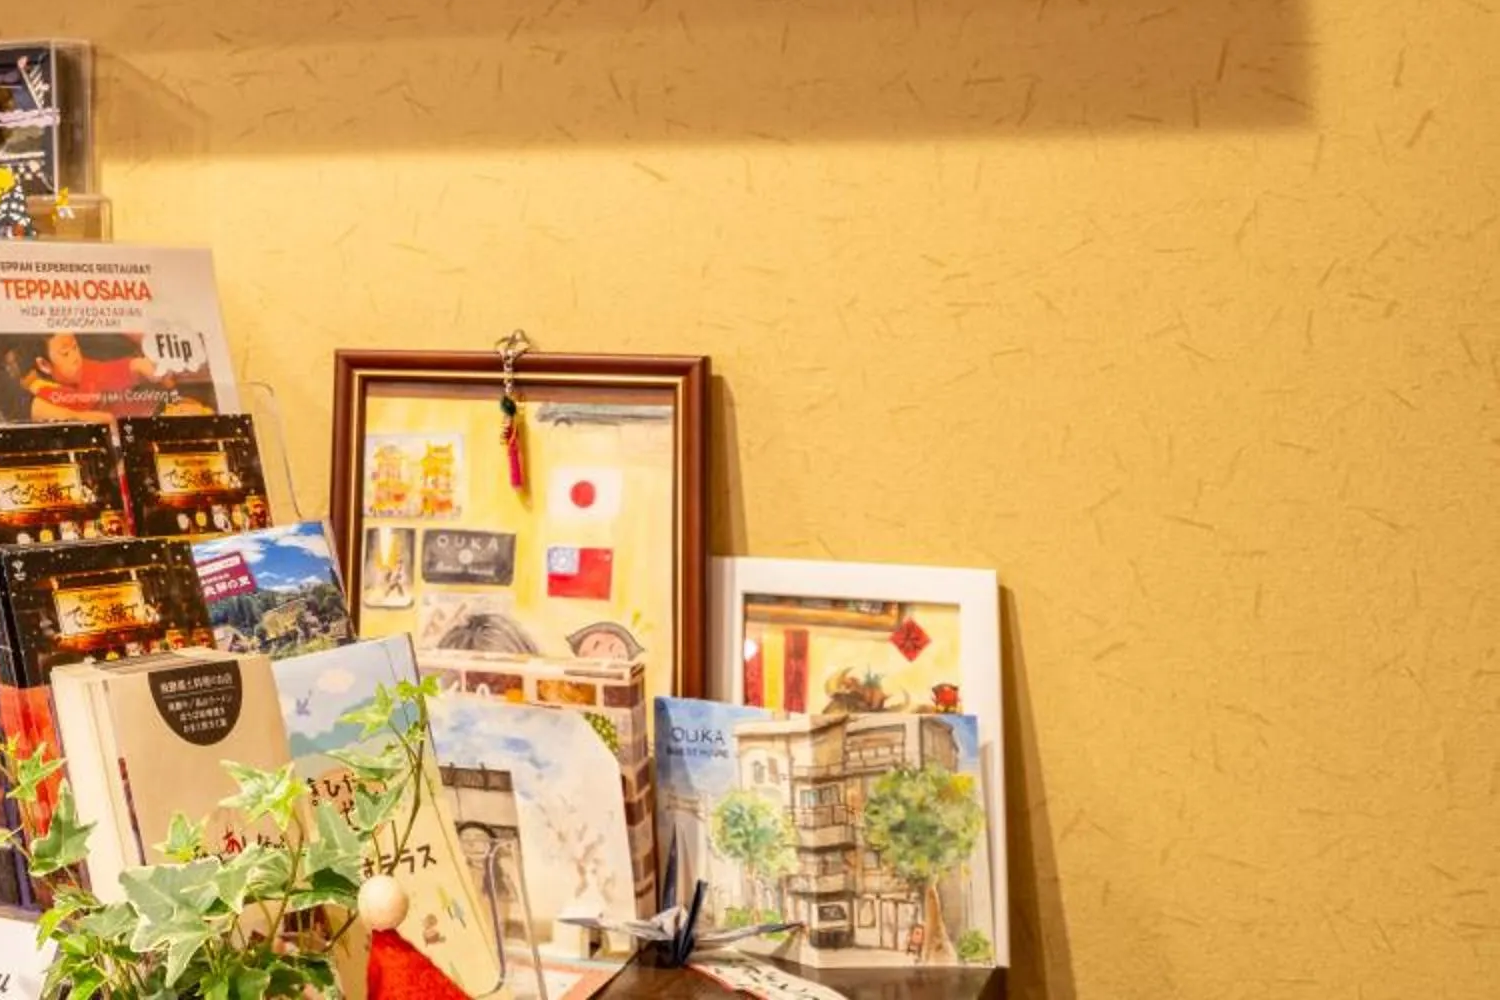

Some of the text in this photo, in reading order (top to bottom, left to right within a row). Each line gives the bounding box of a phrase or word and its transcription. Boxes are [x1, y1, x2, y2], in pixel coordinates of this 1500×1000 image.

[35, 262, 94, 274] EXPERIENCE
[0, 277, 154, 302] TEPPAN OSAKA
[155, 333, 194, 363] Flip
[670, 726, 726, 745] OUKA
